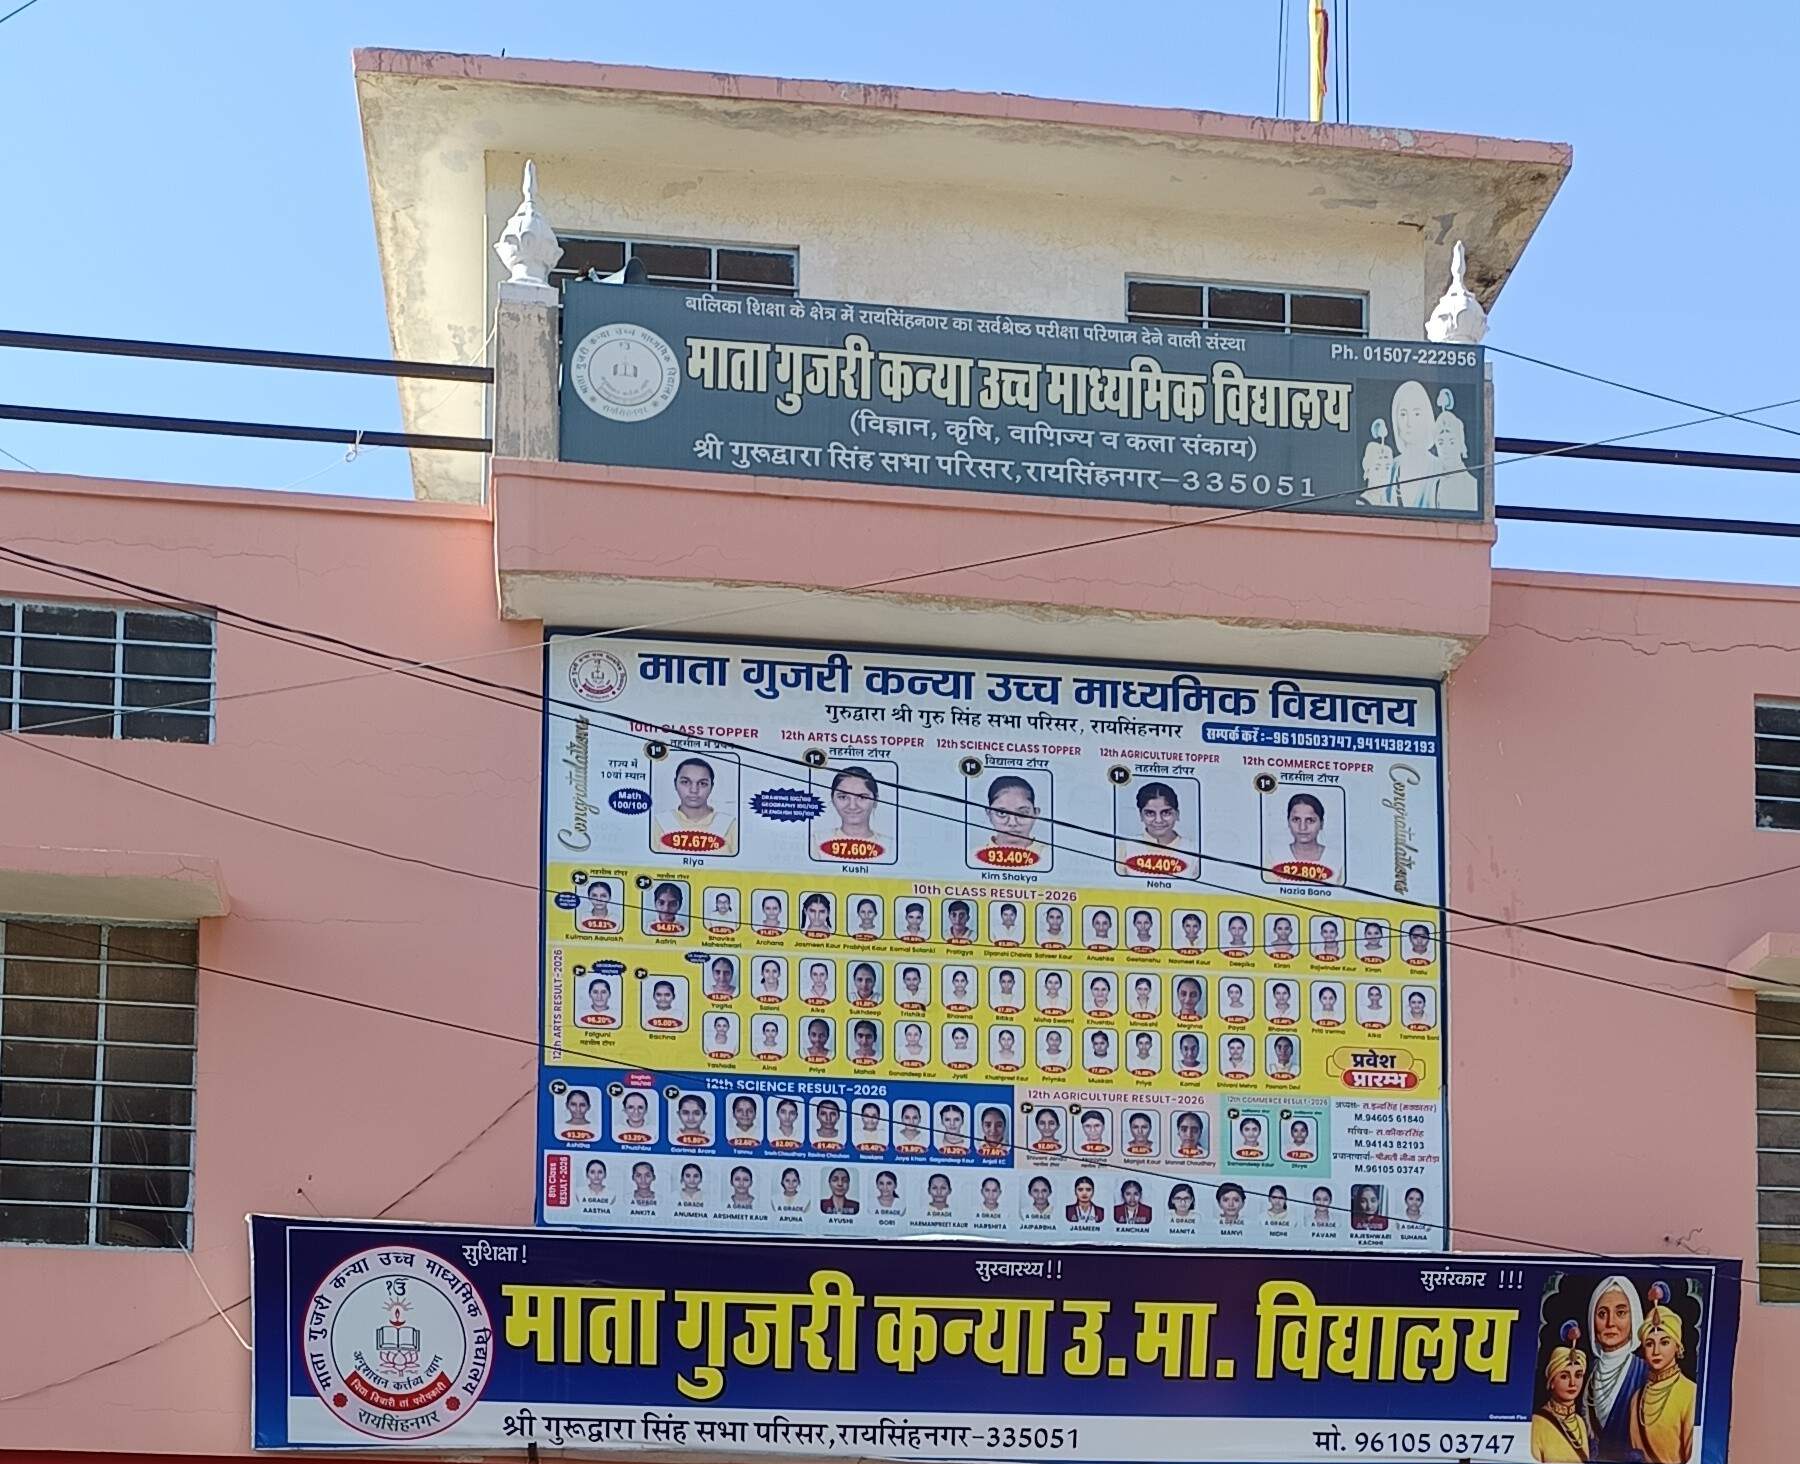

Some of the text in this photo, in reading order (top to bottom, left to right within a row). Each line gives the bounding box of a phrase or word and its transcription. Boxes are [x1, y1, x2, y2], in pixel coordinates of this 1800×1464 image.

[685, 296, 1246, 352] बालिका शिक्षा के क्षेत्र में रायसिंहनगर का सर्वश्रेष्ठ परीक्षा परिणाम देने वाली संस्था
[1331, 344, 1477, 367] Ph. 01507-222956
[685, 335, 771, 393] माता
[775, 333, 875, 416] गुजरी
[879, 351, 973, 407] कन्या
[978, 357, 1043, 415] उच्च
[1046, 354, 1207, 424] माध्यमिक
[1211, 360, 1354, 433] विद्यालय
[850, 408, 1258, 463] (विज्ञान, कृषि, वाणिज्य व कला संकाय)
[692, 434, 723, 462] श्री
[828, 441, 874, 473] सिंह
[881, 453, 931, 475] सभा
[638, 652, 730, 688] माता
[742, 653, 853, 700] गुजरी
[864, 664, 977, 700] कन्या
[987, 673, 1064, 707] उच्च
[1073, 673, 1260, 716] माध्यमिक
[1269, 680, 1418, 728] विद्यालय
[826, 703, 1184, 740] गुरुद्वारा श्री गुरु सिंह सभा परिसर, रायसिंहनगर
[660, 724, 704, 736] CLASS
[706, 726, 759, 739] TOPPER
[781, 730, 925, 748] 12th ARTS CLASS TOPPER
[1206, 725, 1240, 741] सम्पर्क
[936, 738, 1082, 757] 12th SCIENCE CLASS TOPPER
[1100, 748, 1220, 765] 12th AGRICULTURE TOPPER
[1242, 756, 1374, 773] 12th COMMERCE TOPPER
[672, 835, 719, 850] 97.67%
[831, 843, 878, 857] 97.60%
[683, 857, 704, 867] Riya
[988, 850, 1034, 865] 93.40%
[842, 865, 869, 874] Kushi
[981, 872, 1037, 884] Kim Shakya
[913, 884, 1077, 901] 10th CLASS RESULT-2026
[1146, 880, 1172, 889] Neha
[1280, 886, 1332, 897] Nazia Bano
[1351, 1049, 1397, 1069] प्रवेश
[736, 1080, 795, 1093] SCIENCE
[798, 1082, 887, 1097] RESULT-2026
[1351, 1071, 1409, 1089] प्रारम्भ
[1027, 1089, 1205, 1105] 12th AGRICULTURE RESULT-2026
[1396, 1165, 1425, 1175] 03747
[1420, 1265, 1487, 1292] सुसंस्कार
[308, 1251, 492, 1397] माता गुजरी कन्या उच्च माध्यमिक विद्यालय
[501, 1268, 1520, 1401] माता गुजरी कन्या उ.मा. विद्यालय
[358, 1408, 441, 1433] रायसिंहनगर
[503, 1408, 537, 1437] श्री
[641, 1412, 689, 1445] सिंह
[695, 1421, 749, 1443] सभा
[1314, 1422, 1515, 1456] मो. 96105 03747
